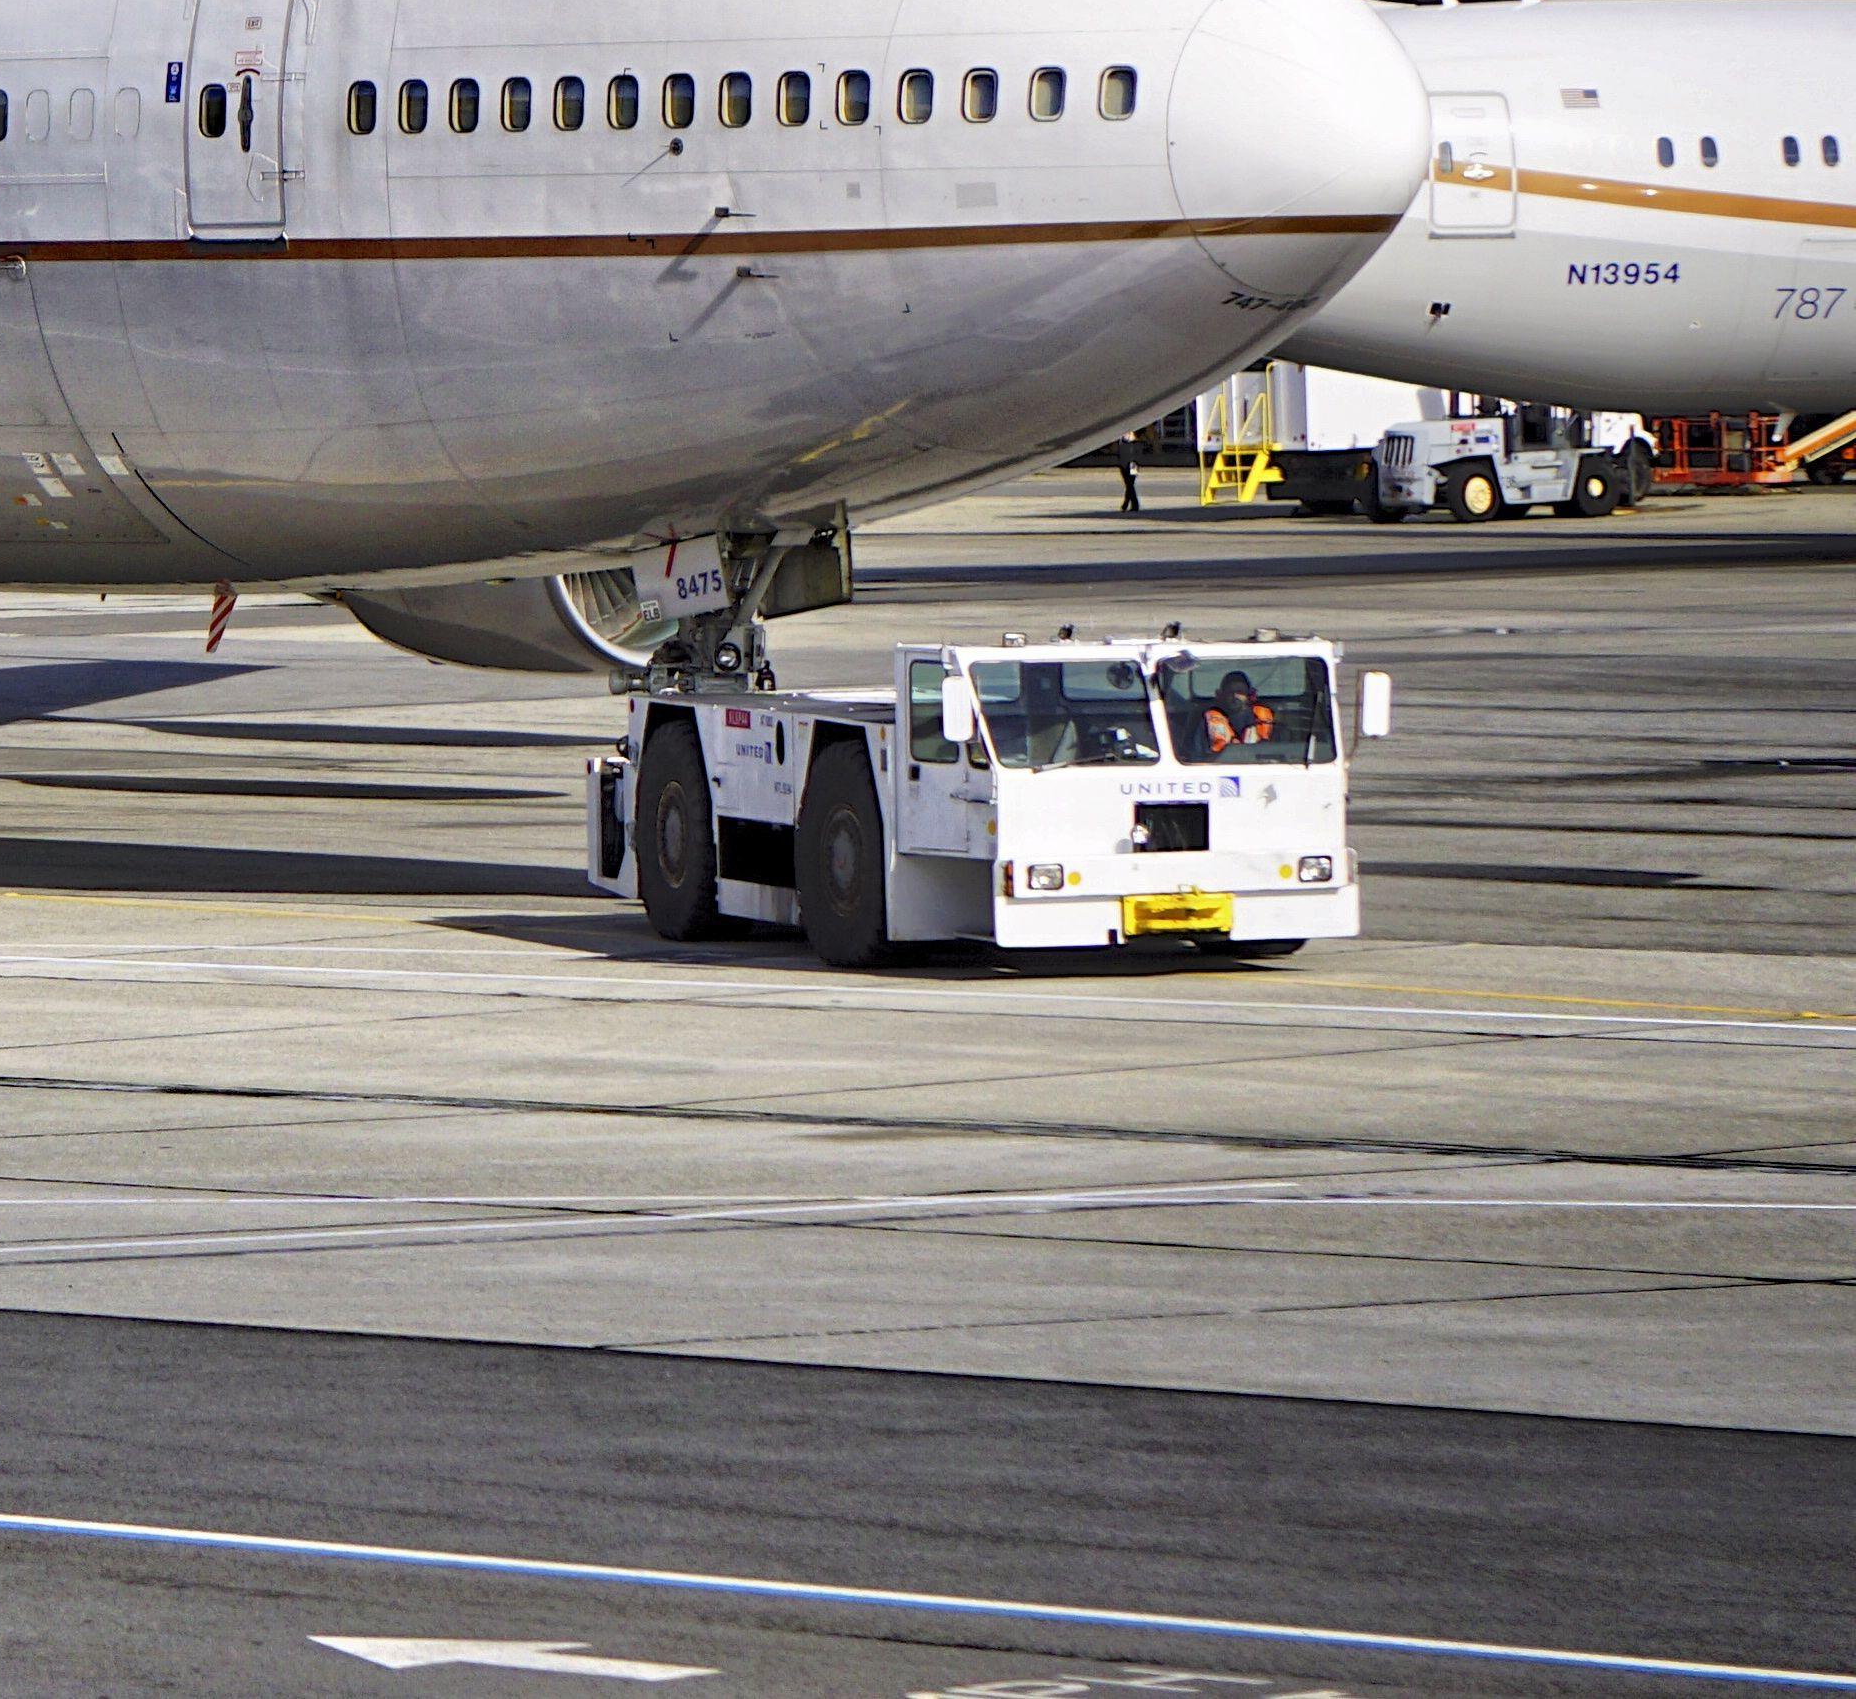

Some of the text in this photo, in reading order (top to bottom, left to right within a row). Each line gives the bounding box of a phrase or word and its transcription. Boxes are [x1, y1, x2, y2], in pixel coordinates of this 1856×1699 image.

[1567, 262, 1681, 286] N13954
[1774, 287, 1848, 320] 787
[675, 568, 723, 600] 8475
[735, 743, 764, 759] UNITED
[1120, 781, 1212, 796] UNITED
